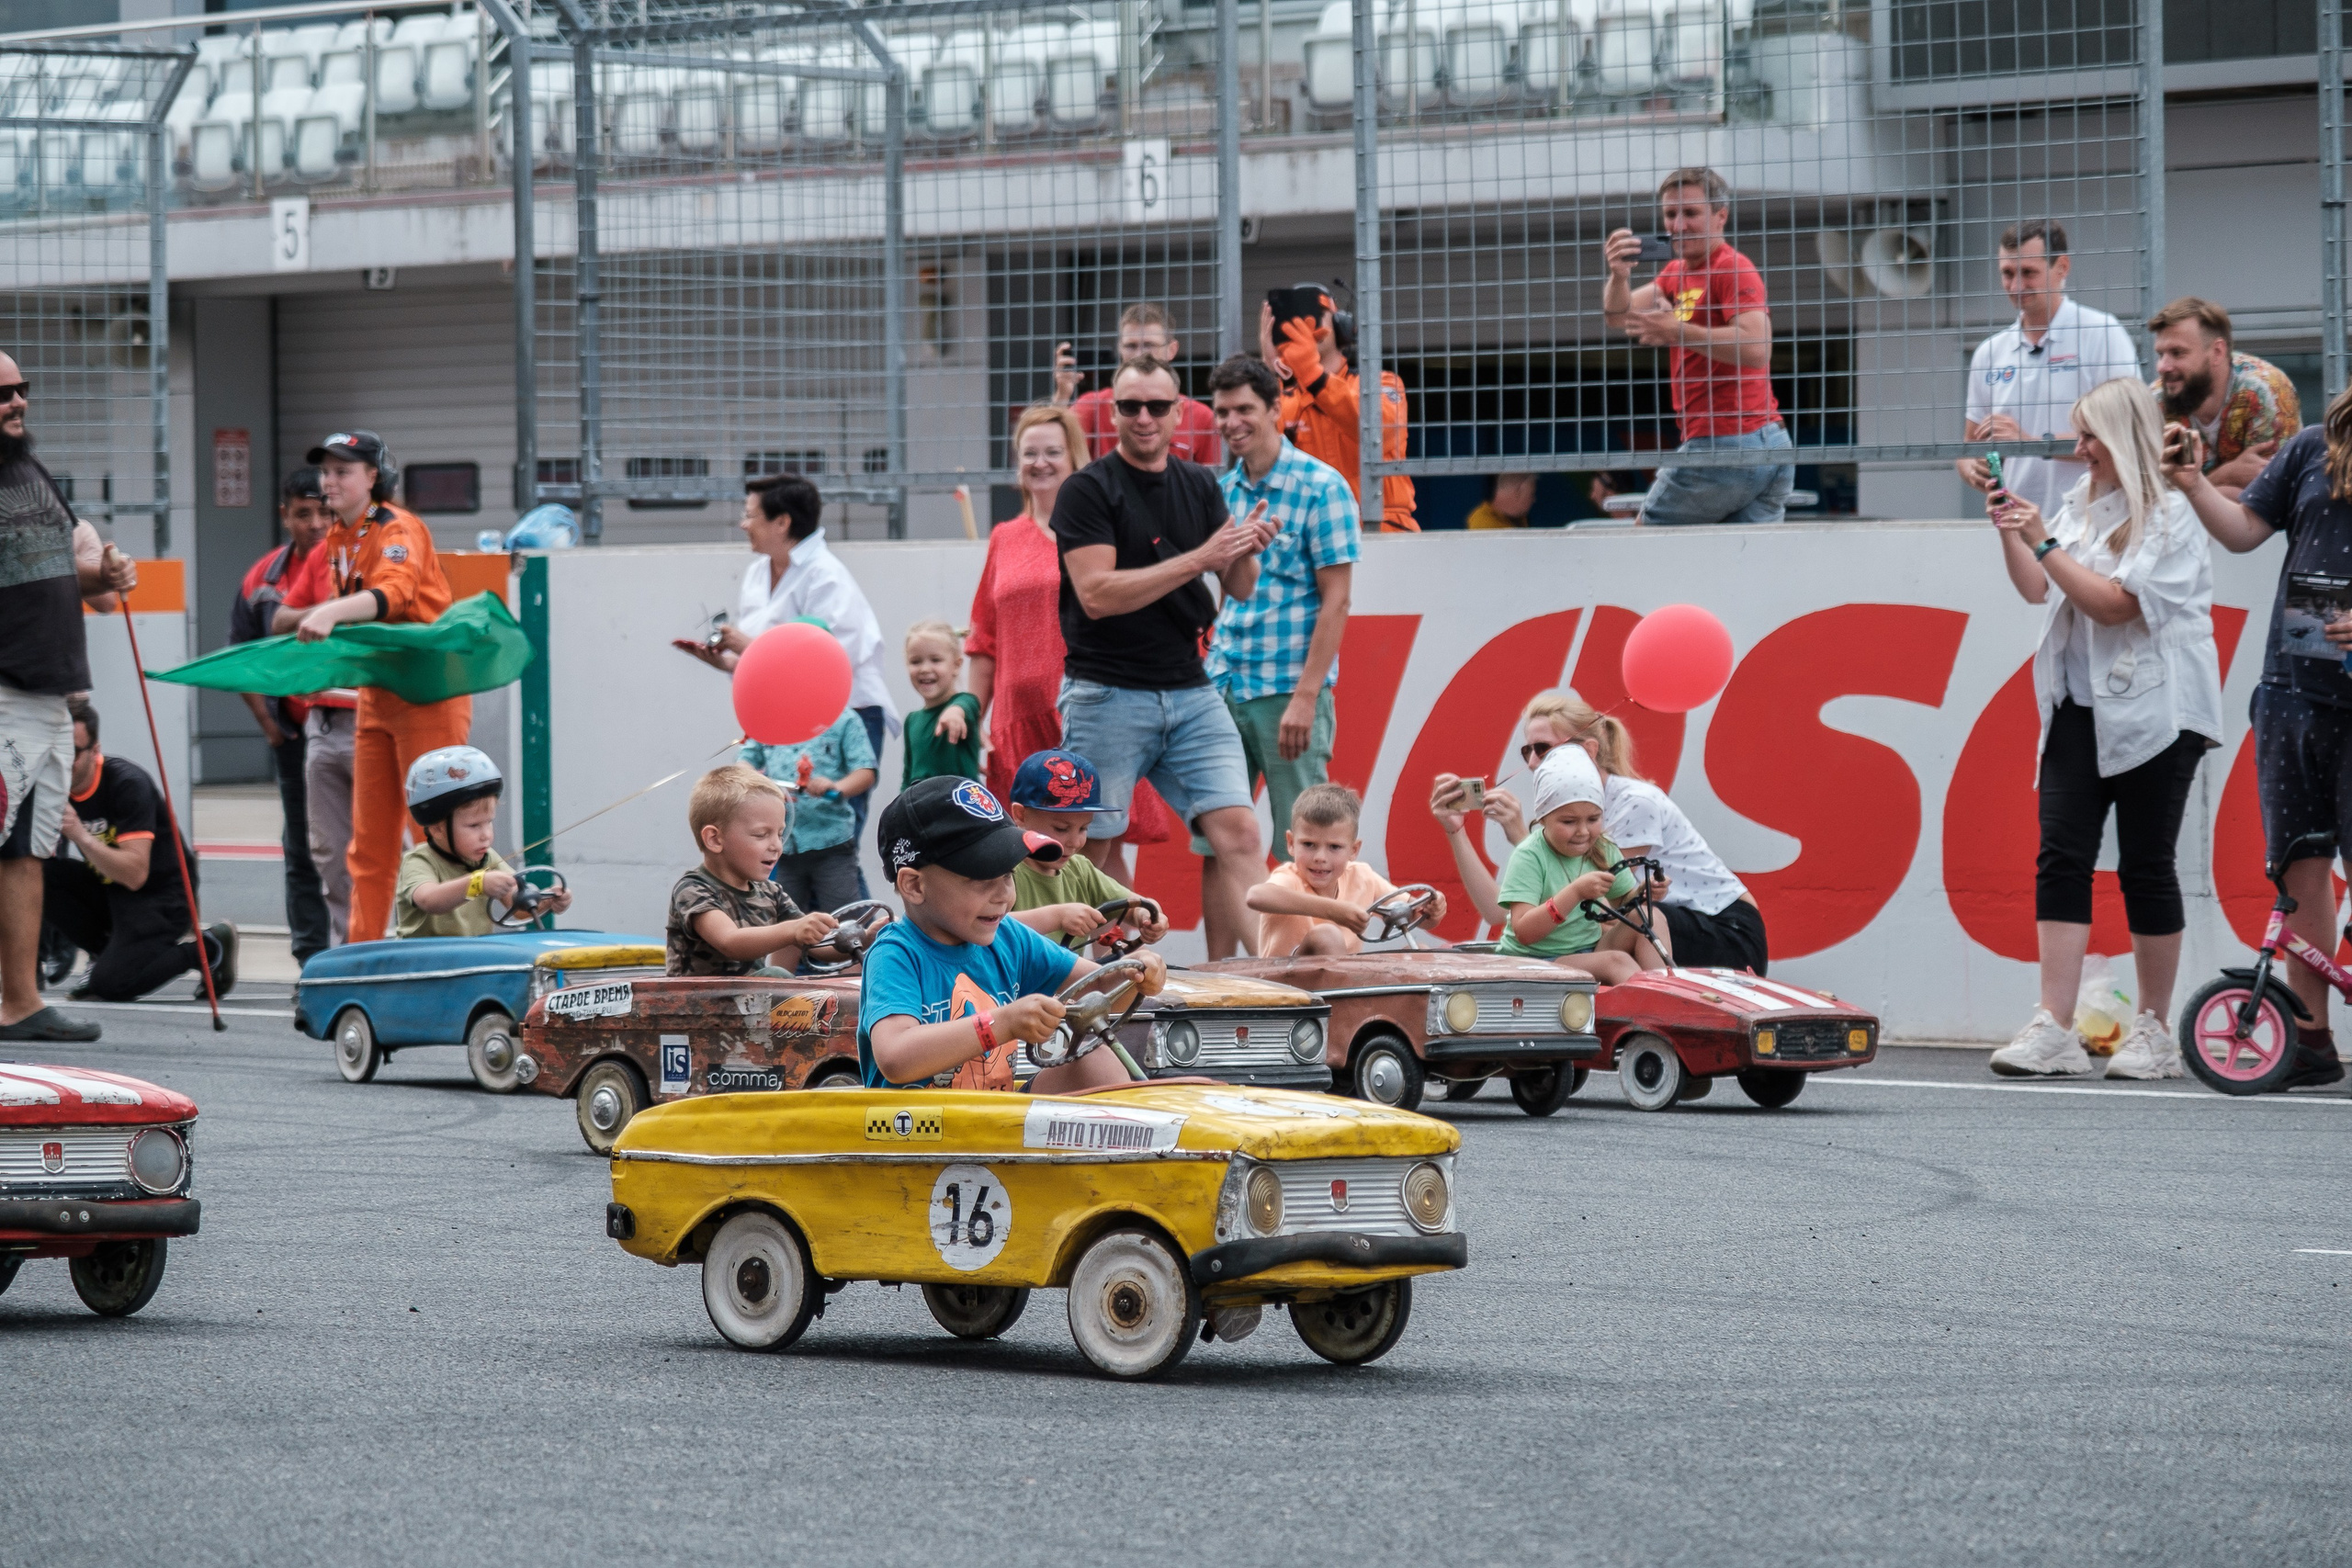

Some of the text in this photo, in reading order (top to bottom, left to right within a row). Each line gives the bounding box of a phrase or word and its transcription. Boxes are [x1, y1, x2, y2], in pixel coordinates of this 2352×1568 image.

[1141, 153, 1159, 208] 6
[284, 209, 299, 260] 5
[548, 984, 630, 1011] СТАРОЕ ВРЕМЯ
[1046, 1120, 1155, 1151] АВТО ТУШИНО
[946, 1182, 994, 1247] 16
